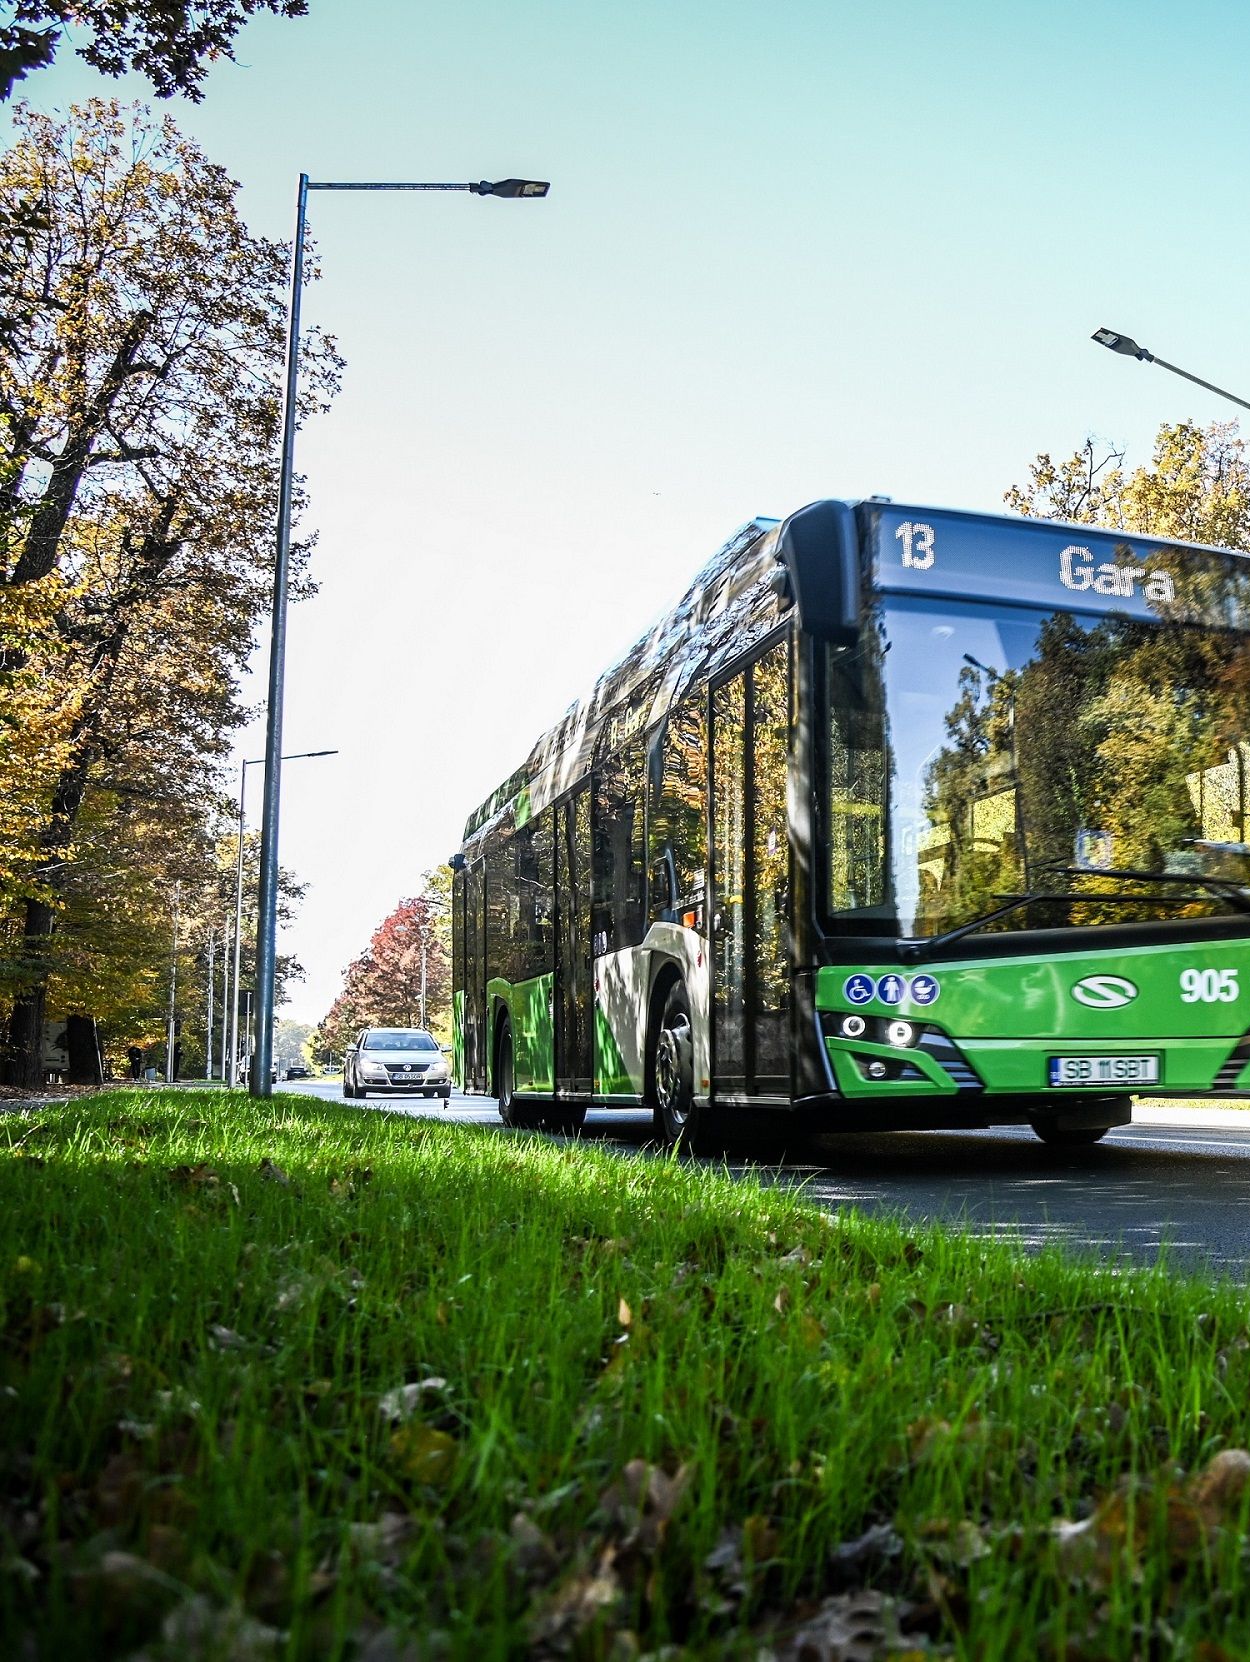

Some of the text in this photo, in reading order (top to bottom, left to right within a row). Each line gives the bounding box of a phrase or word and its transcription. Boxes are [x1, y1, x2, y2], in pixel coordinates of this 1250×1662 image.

[895, 521, 1176, 603] 13 Gara
[1179, 968, 1240, 1003] 905
[1064, 1060, 1092, 1079] SB
[1113, 1059, 1150, 1078] SBT
